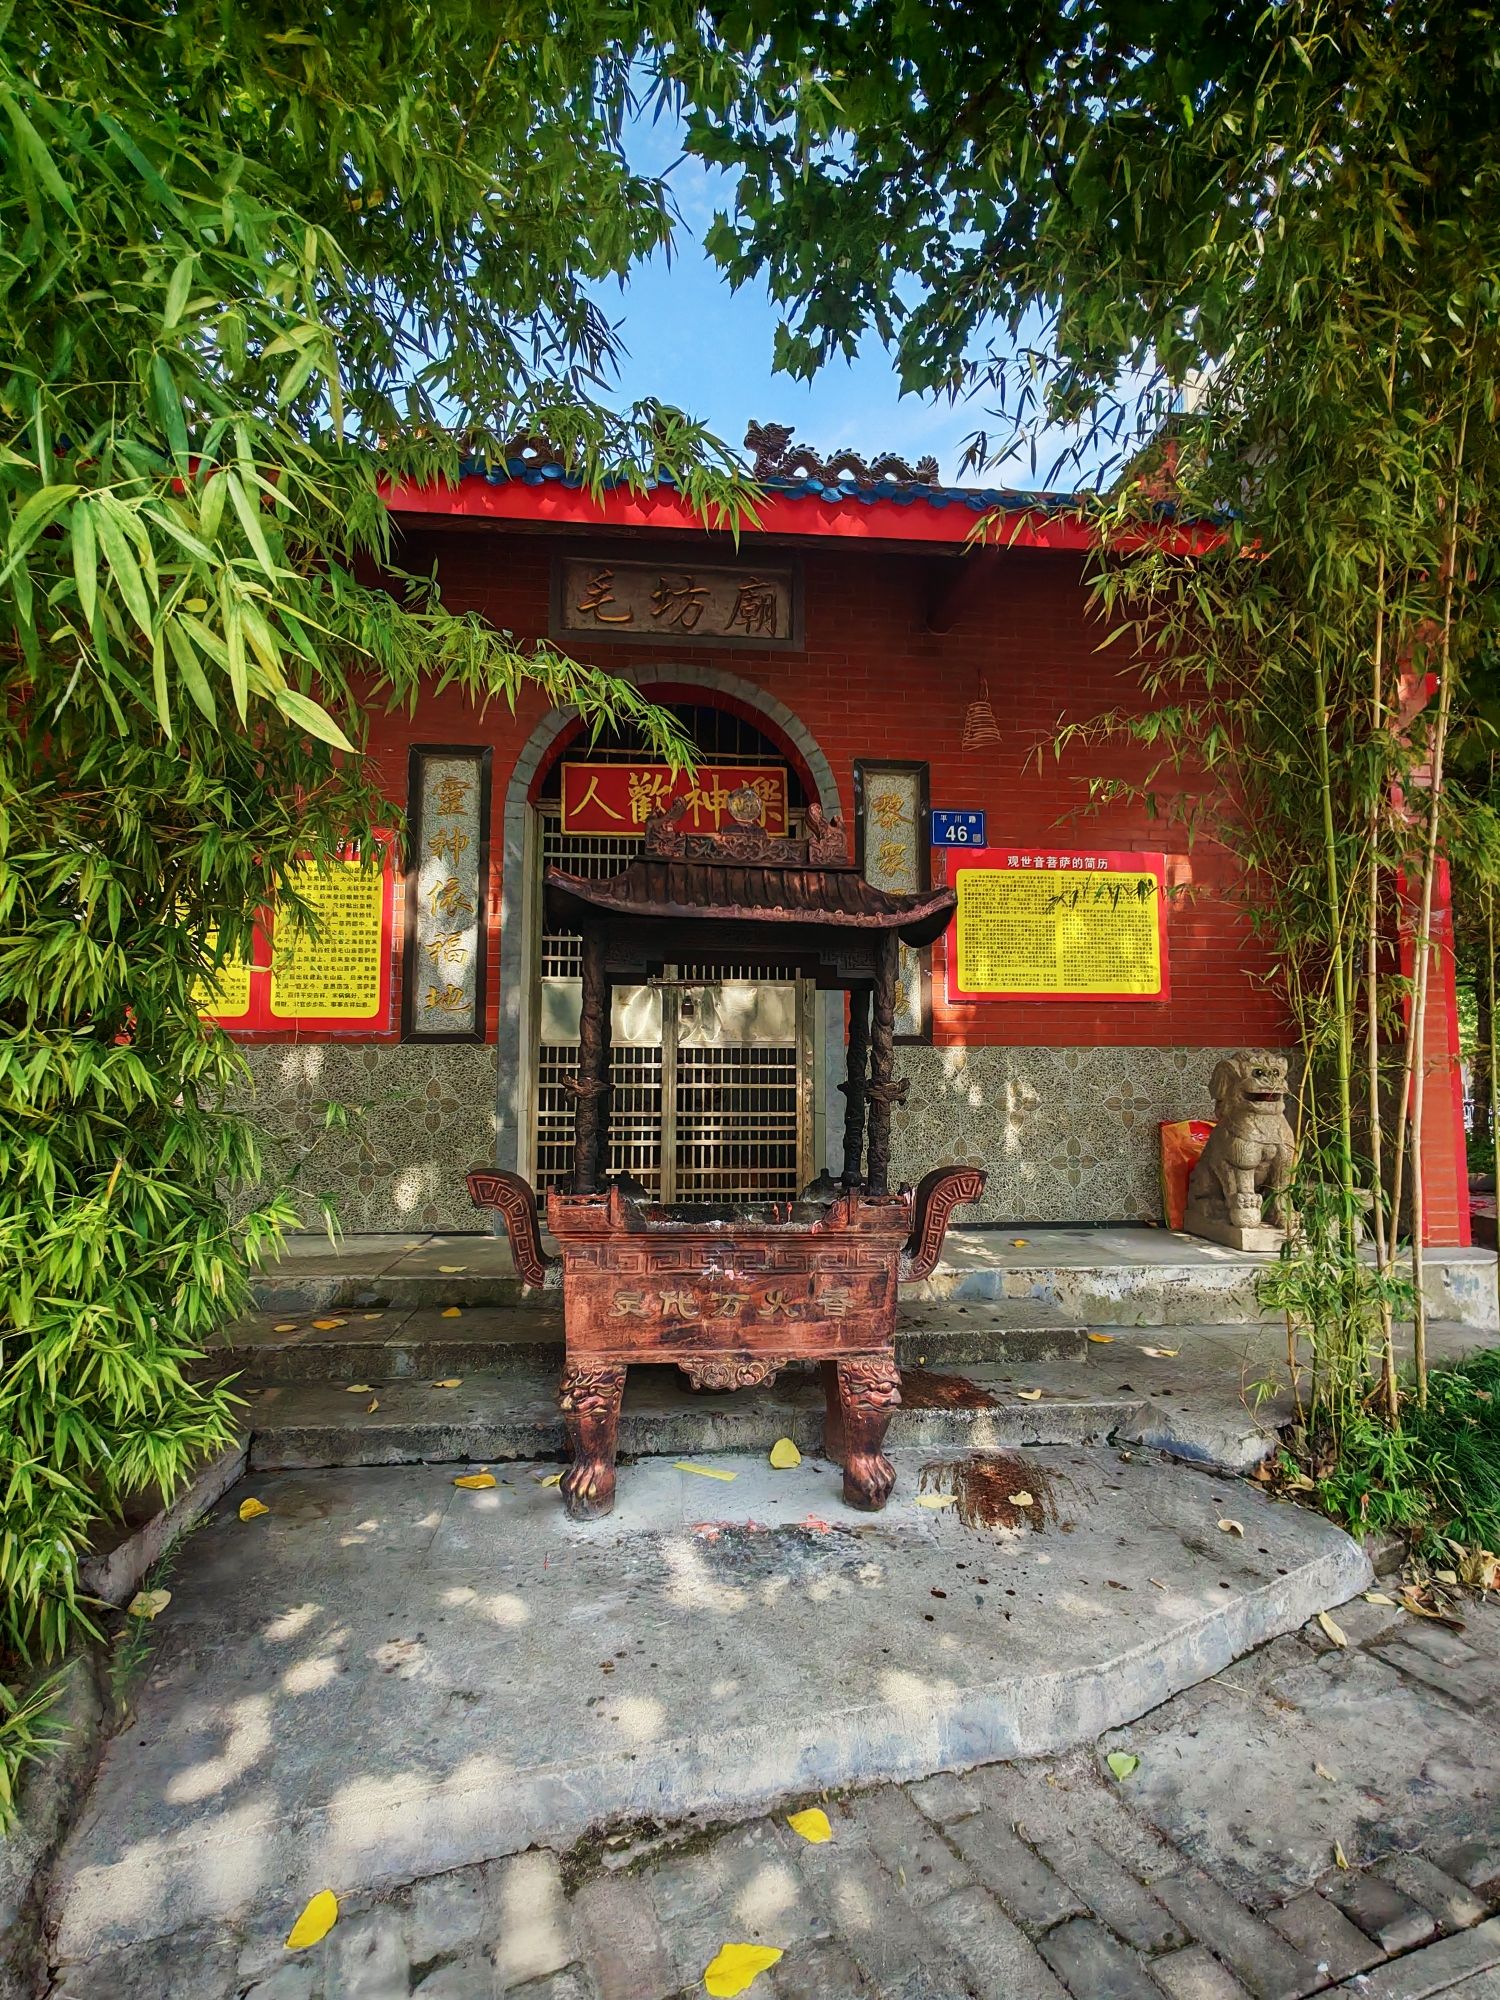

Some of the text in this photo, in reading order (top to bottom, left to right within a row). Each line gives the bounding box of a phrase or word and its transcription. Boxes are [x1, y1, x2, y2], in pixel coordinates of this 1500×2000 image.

[940, 814, 977, 824] 平川路
[945, 825, 968, 842] 46
[1007, 855, 1109, 870] 观世音菩萨的简历
